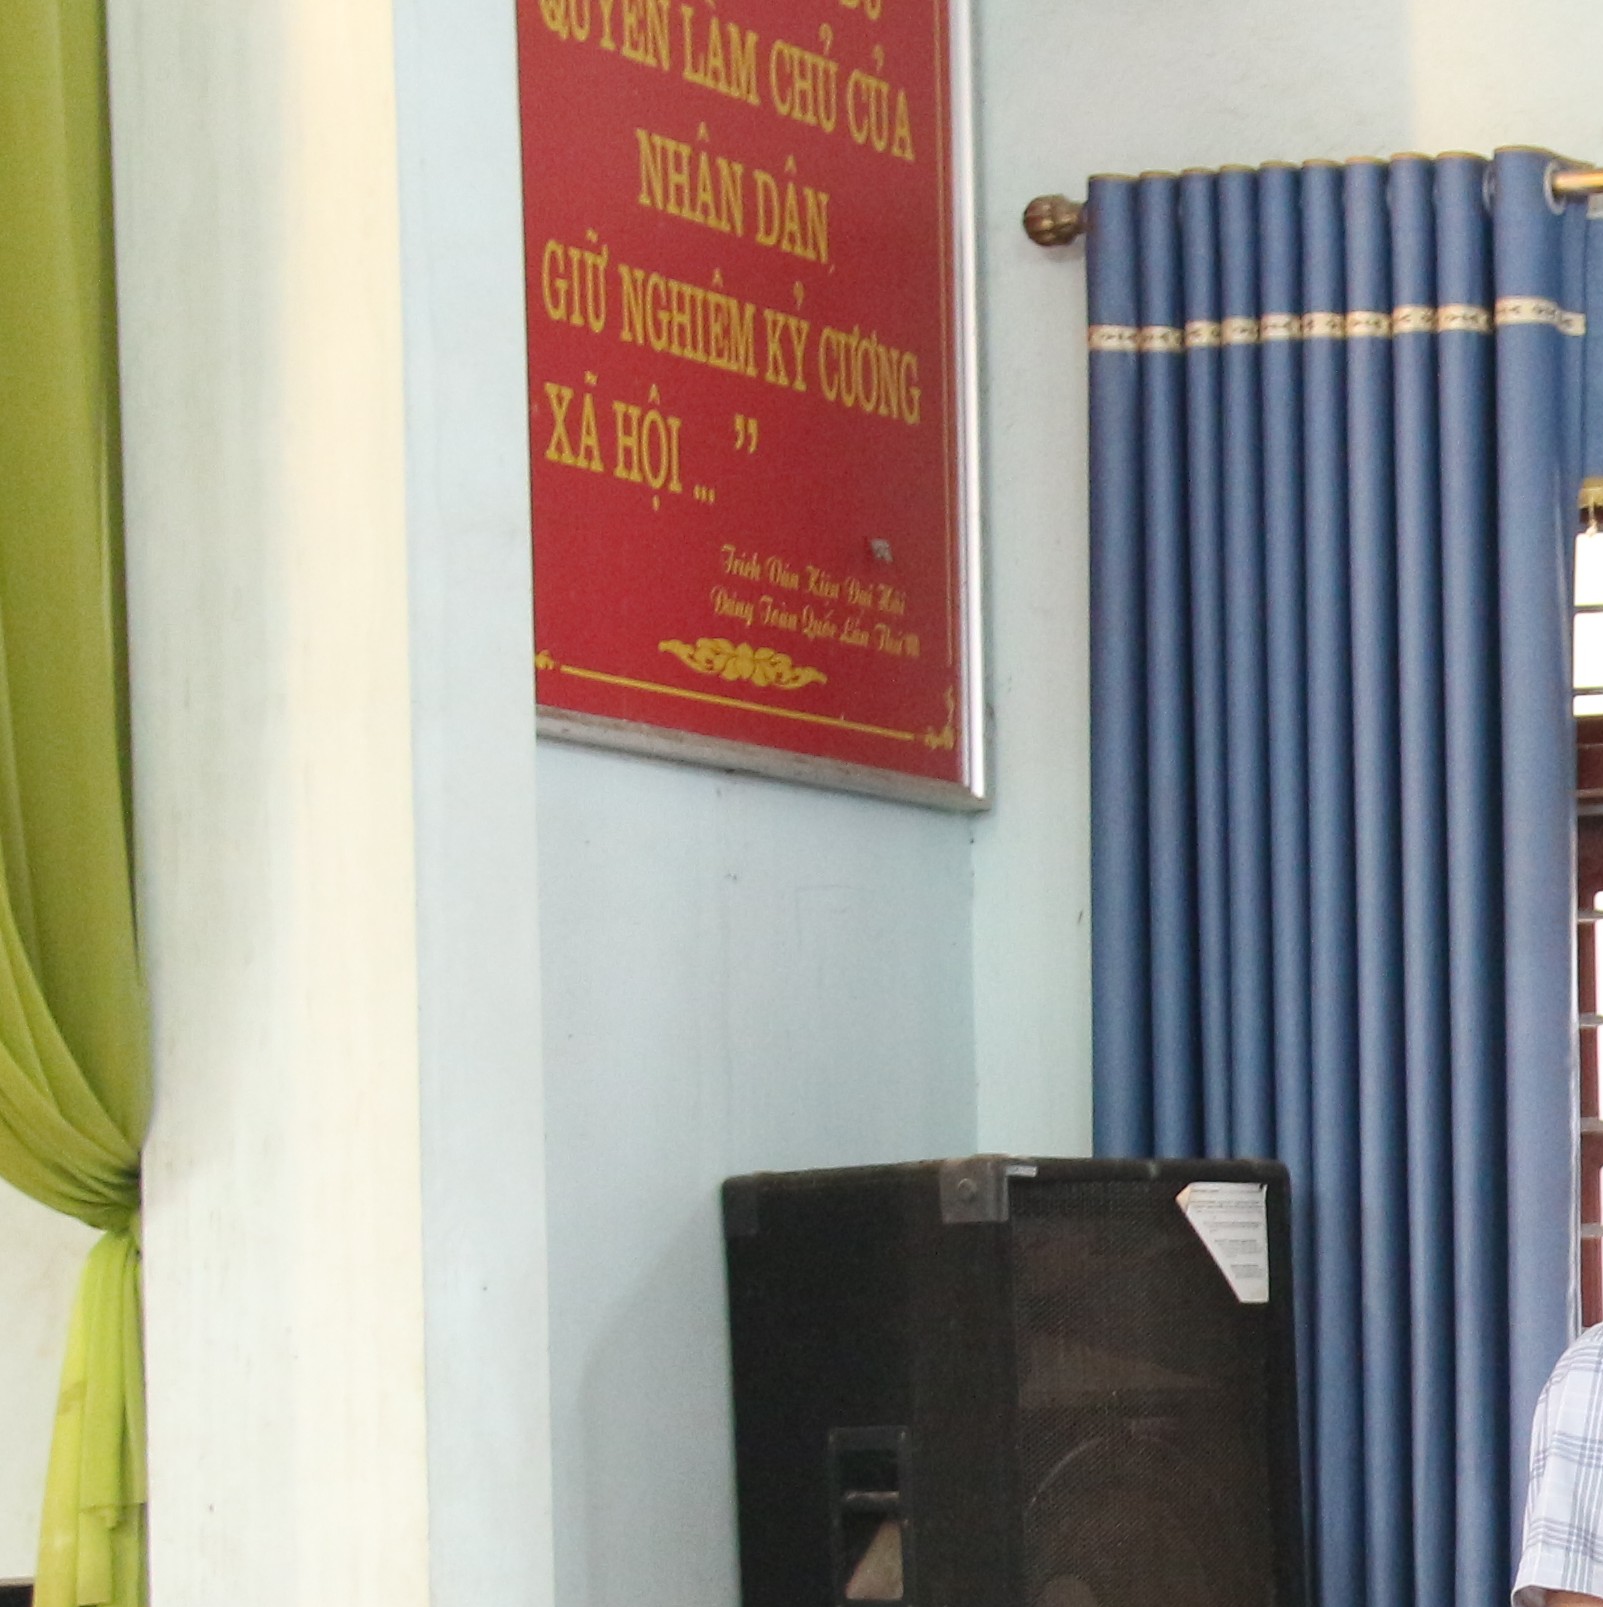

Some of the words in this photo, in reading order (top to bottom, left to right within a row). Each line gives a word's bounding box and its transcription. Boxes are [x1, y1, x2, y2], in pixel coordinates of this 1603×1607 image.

[769, 22, 839, 133] CHỦ
[847, 44, 915, 162] CỦA
[635, 121, 744, 238] NHÂN
[754, 154, 830, 265] DÂN
[542, 228, 609, 333] GIỮ
[617, 264, 757, 378] NGHIÊM
[763, 280, 811, 392] KỶ
[818, 323, 922, 426] CƯƠNG
[544, 370, 604, 473] XÃ
[612, 383, 682, 512] HỘI
